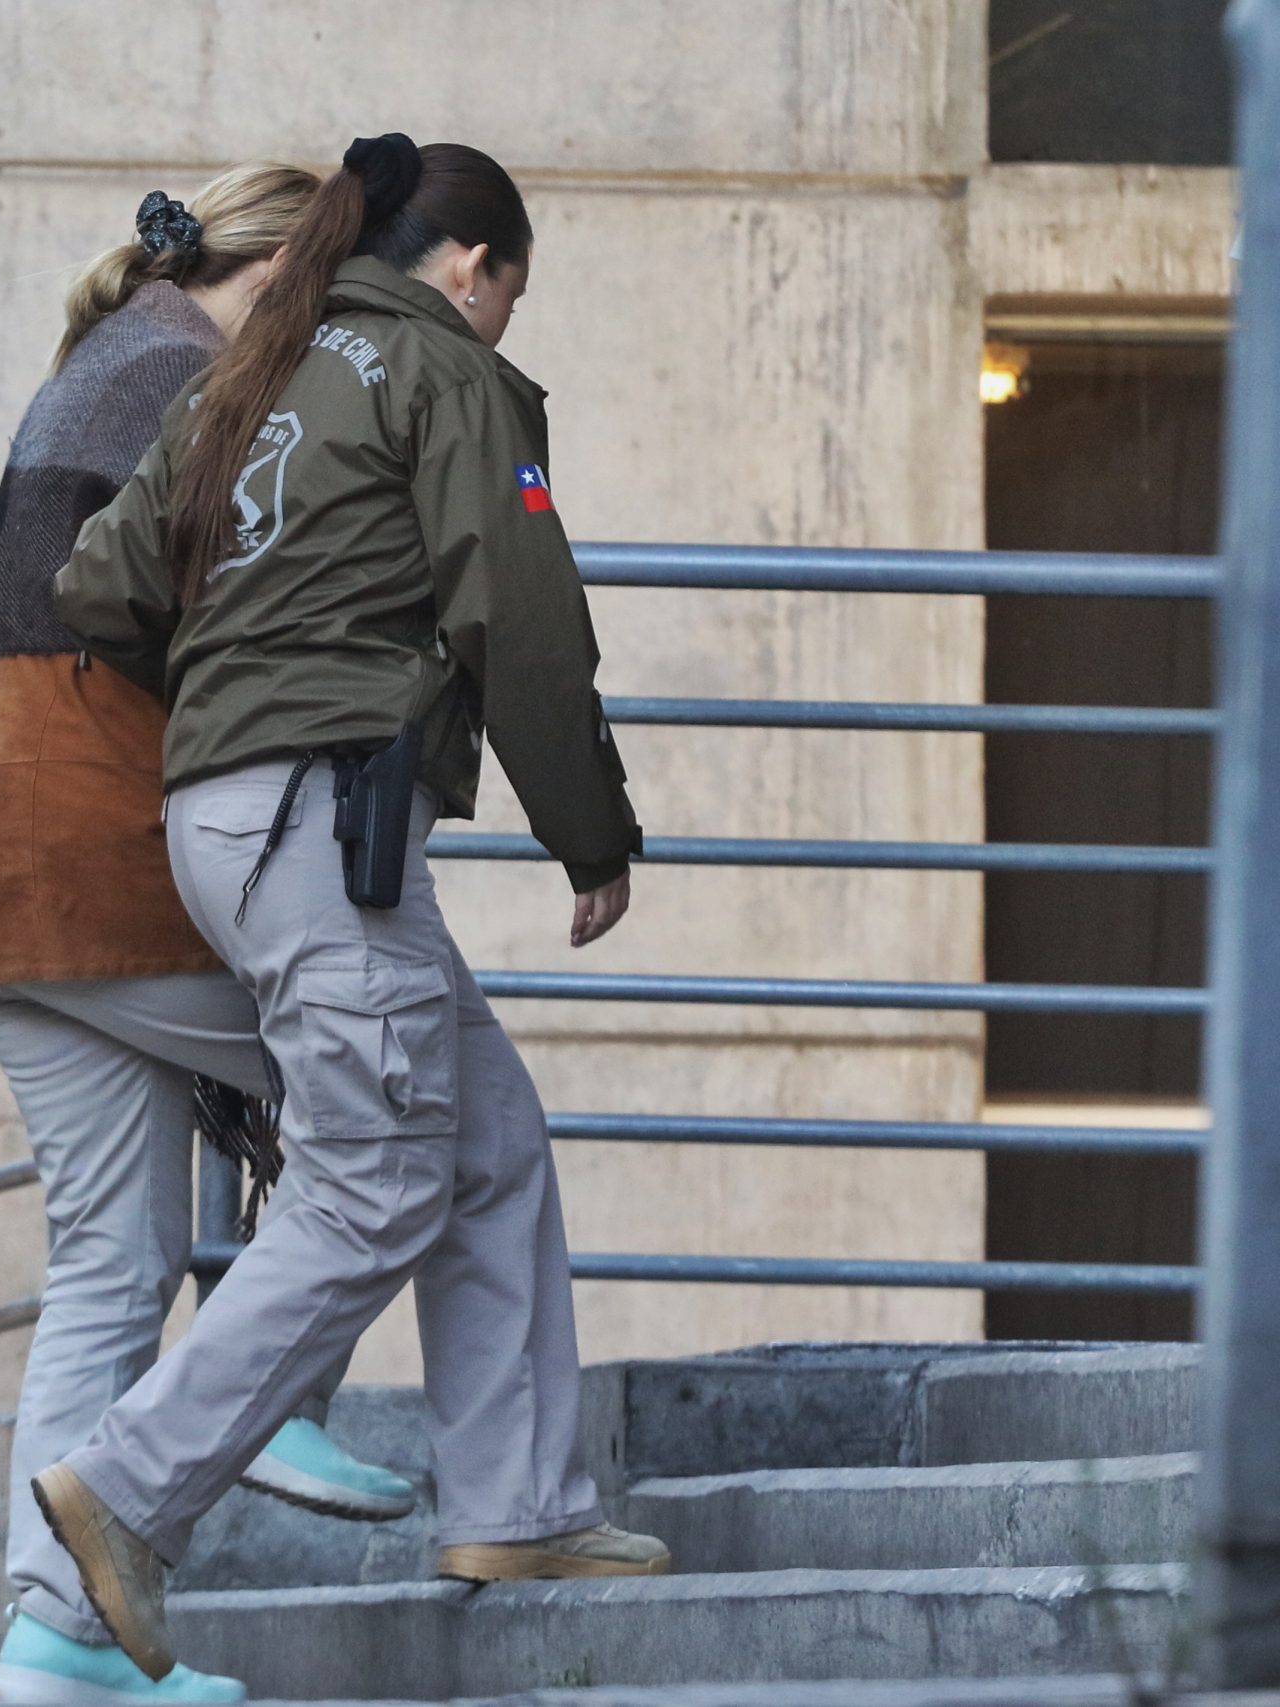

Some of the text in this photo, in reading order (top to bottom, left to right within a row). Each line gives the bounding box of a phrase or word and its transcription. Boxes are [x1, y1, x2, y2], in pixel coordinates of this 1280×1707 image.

[320, 327, 354, 351] DE
[342, 337, 386, 387] CHILE
[272, 428, 290, 445] DE
